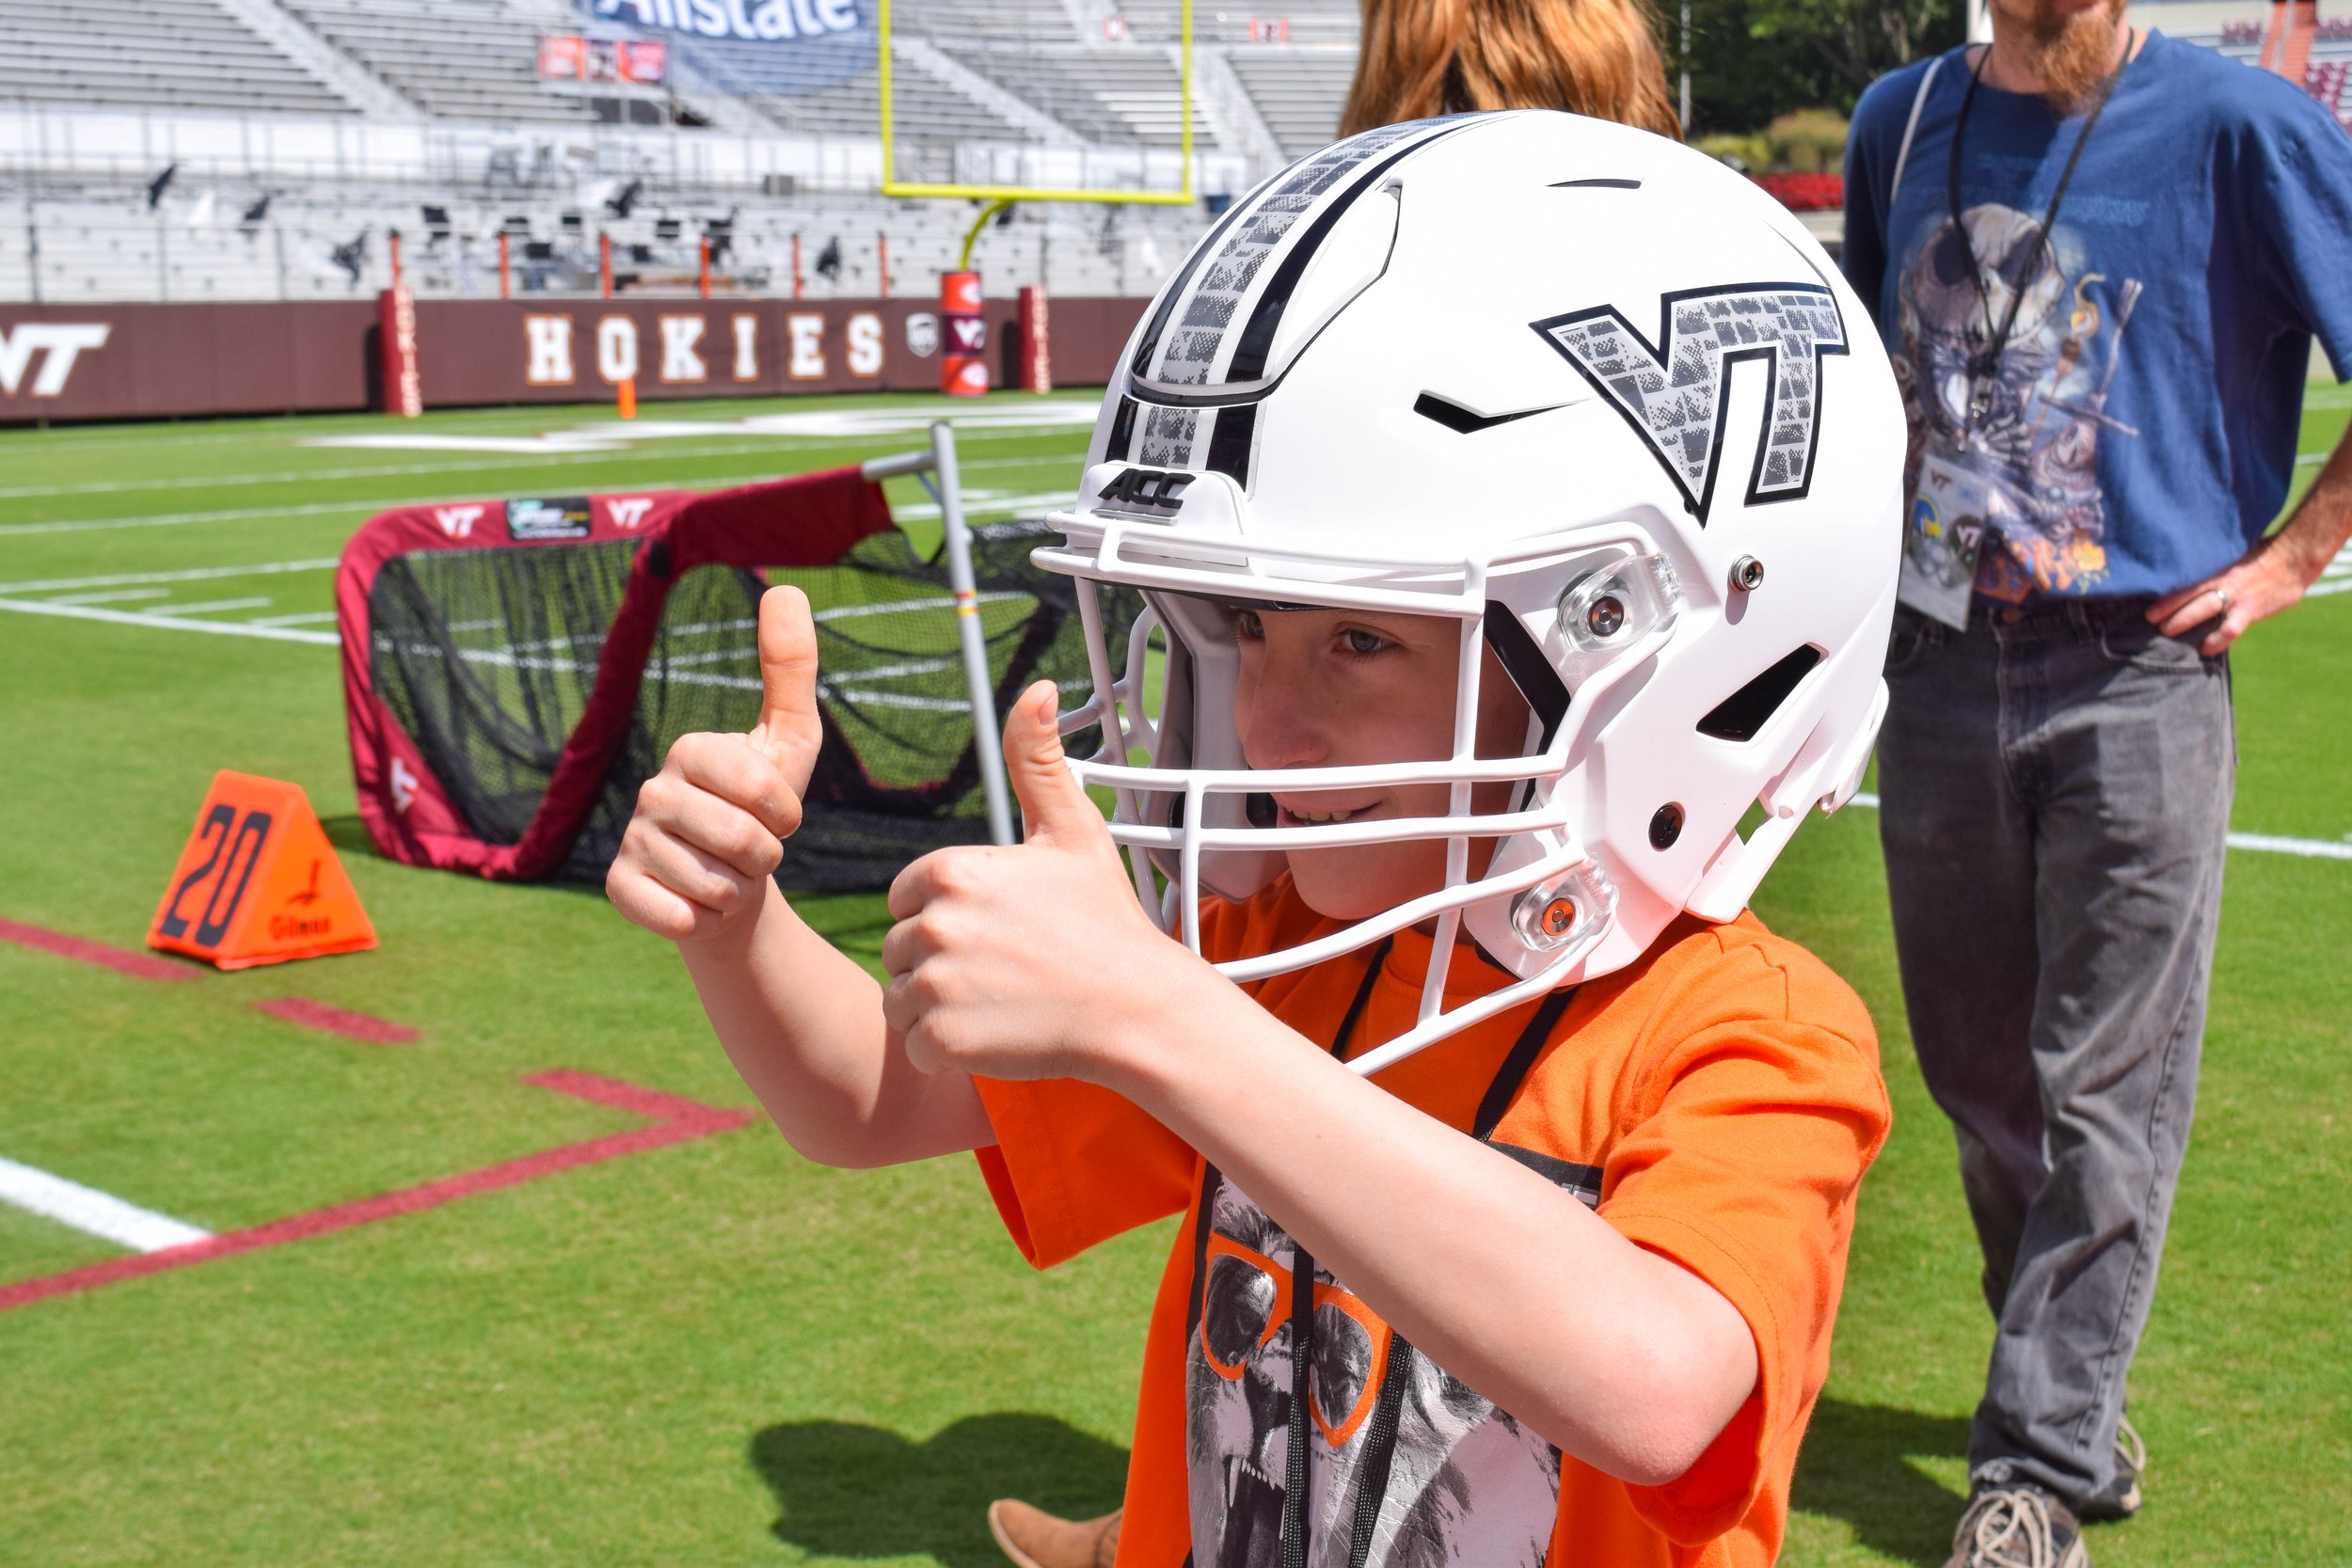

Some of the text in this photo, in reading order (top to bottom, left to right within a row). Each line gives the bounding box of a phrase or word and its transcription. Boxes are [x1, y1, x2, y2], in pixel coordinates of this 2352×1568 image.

[523, 310, 885, 387] HOKIES
[1528, 281, 1850, 531] VT
[607, 499, 654, 529] VT
[1097, 467, 1197, 509] ACC
[434, 504, 485, 539] VT
[159, 803, 272, 948] 20
